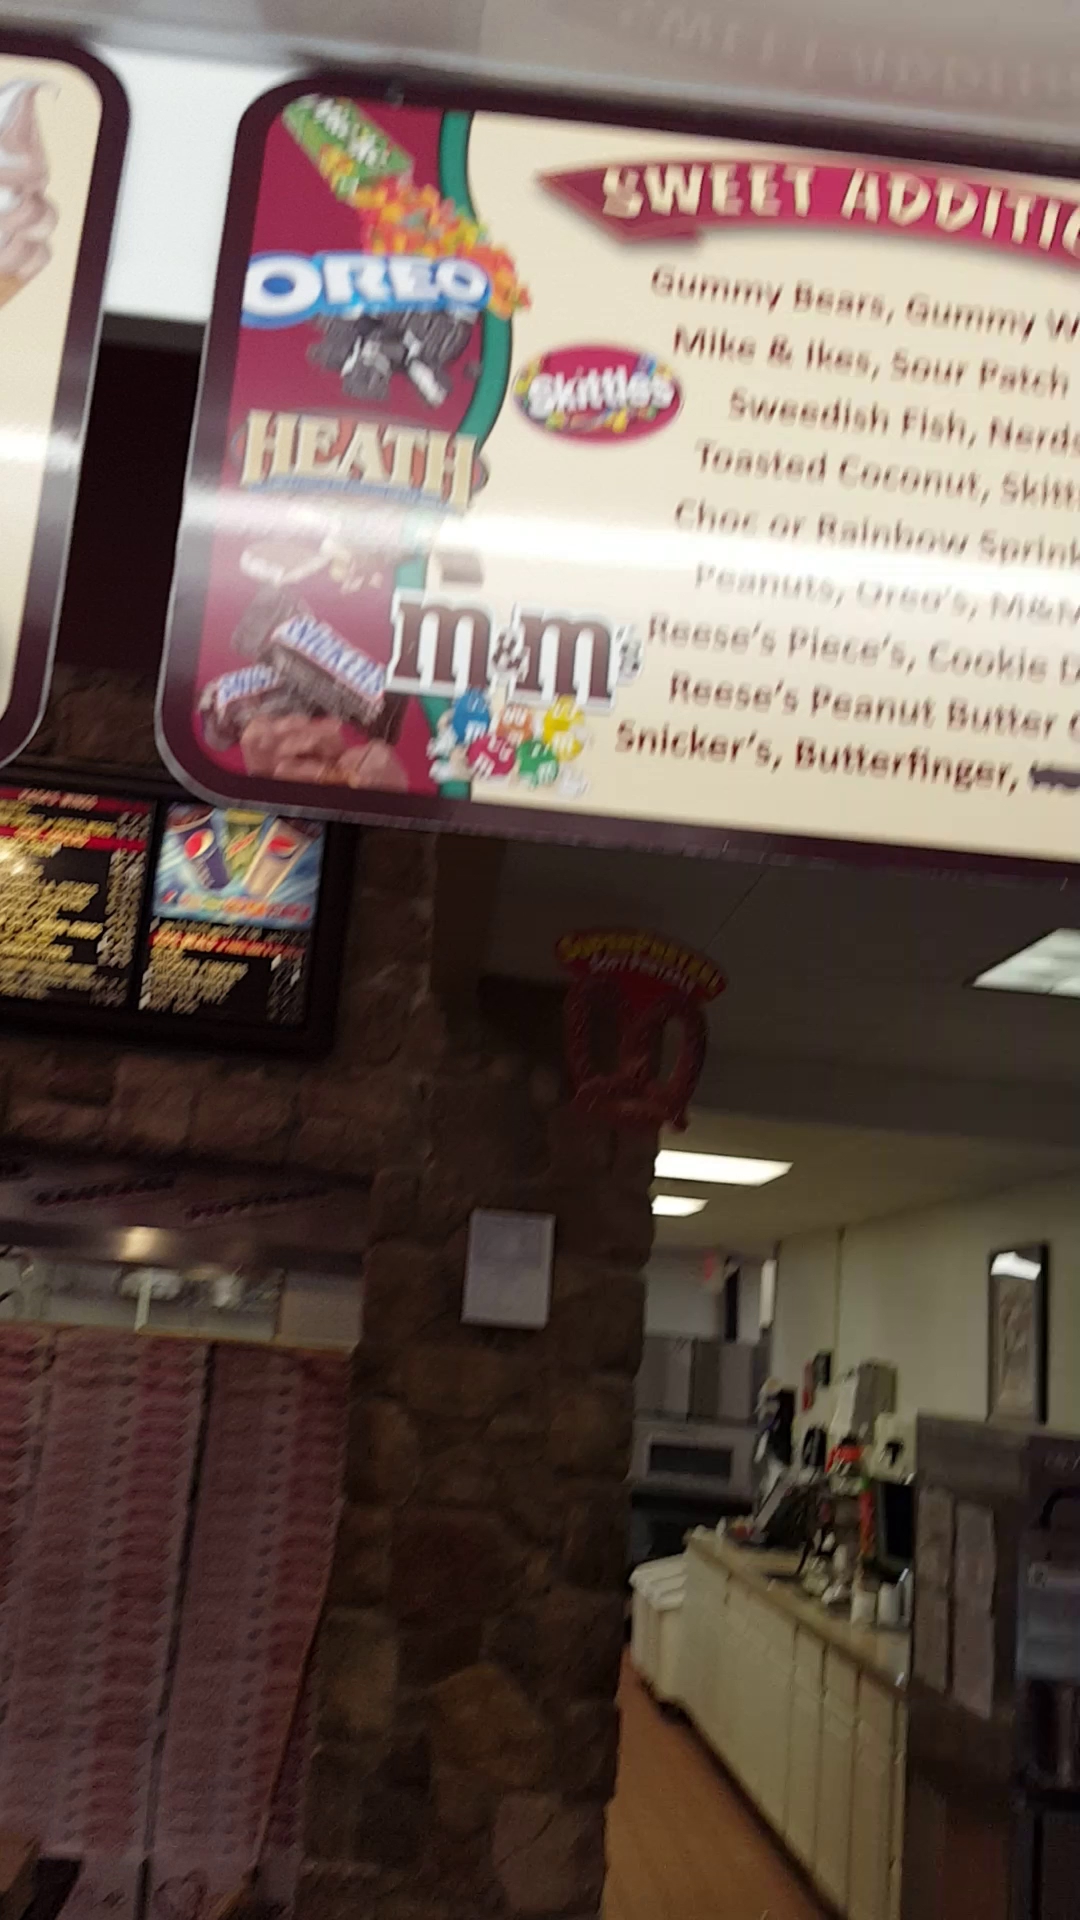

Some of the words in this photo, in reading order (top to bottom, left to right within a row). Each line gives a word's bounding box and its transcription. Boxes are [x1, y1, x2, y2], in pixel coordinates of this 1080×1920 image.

[603, 163, 814, 218] SWEET
[245, 256, 488, 316] OREO
[651, 264, 783, 311] Gummy
[793, 280, 897, 326] Bears,
[905, 292, 1036, 343] Gummy
[528, 364, 674, 420] Skittles
[673, 323, 756, 365] Mike
[767, 334, 792, 369] &
[892, 349, 968, 392] Sour
[978, 359, 1069, 401] Patch
[730, 386, 890, 436] Sweedish
[902, 405, 977, 450] Fish,
[240, 411, 478, 510] HEATH
[696, 443, 827, 485] Toasted
[838, 453, 990, 508] Coconut,
[675, 497, 754, 534] Choc
[768, 510, 806, 540] or
[817, 511, 971, 557] Rainbow
[695, 562, 847, 609] Peanuts,
[648, 612, 776, 656] Reese's
[788, 628, 916, 675] Piece's,
[928, 639, 1047, 684] Cookie
[669, 669, 799, 715] Reese's
[810, 685, 936, 731] Peanut
[947, 697, 1057, 740] Butter
[615, 718, 783, 774] Snicker's,
[795, 736, 1019, 797] Butterfinger,
